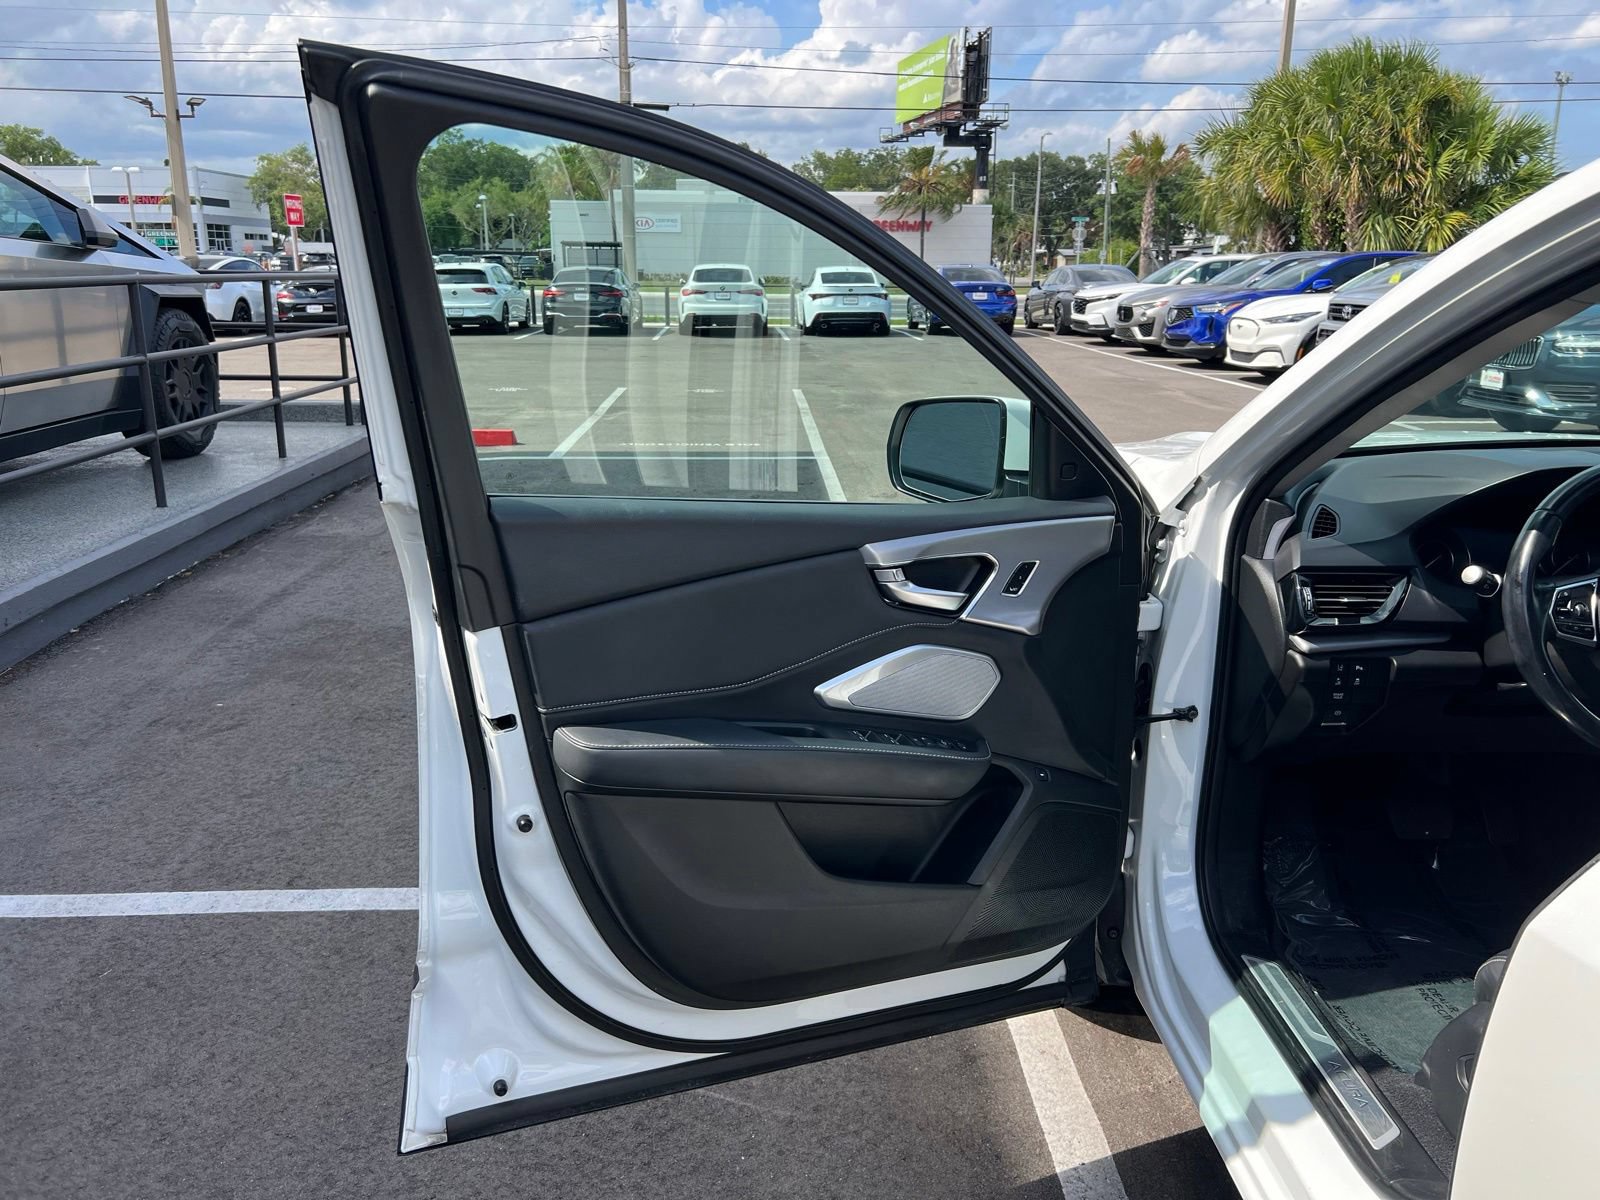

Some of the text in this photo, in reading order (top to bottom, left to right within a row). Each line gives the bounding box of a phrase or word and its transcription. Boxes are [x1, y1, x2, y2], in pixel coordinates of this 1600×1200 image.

[119, 195, 170, 204] GRENW
[285, 199, 302, 209] WRONG
[289, 212, 300, 222] WAY
[1327, 1060, 1369, 1108] ACURA
